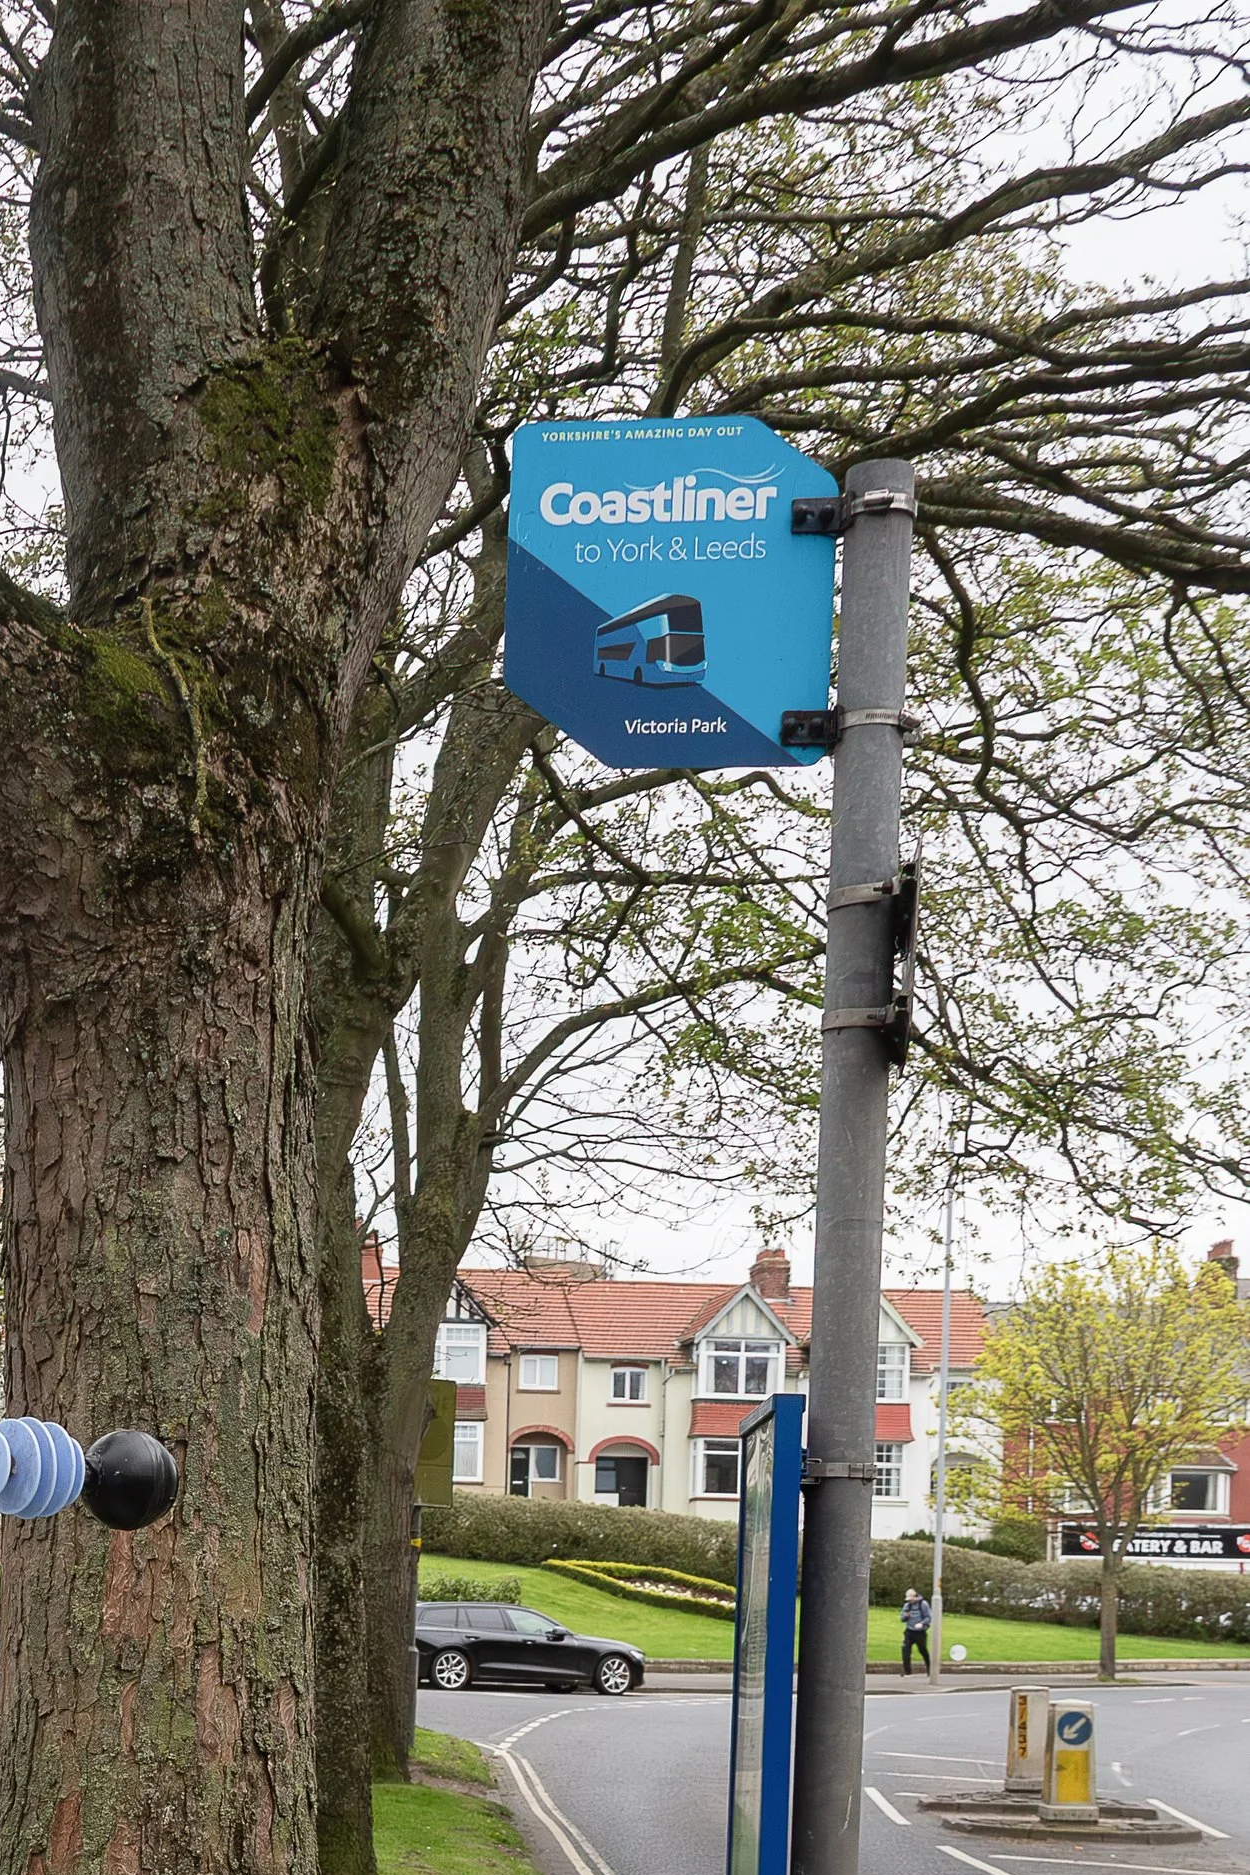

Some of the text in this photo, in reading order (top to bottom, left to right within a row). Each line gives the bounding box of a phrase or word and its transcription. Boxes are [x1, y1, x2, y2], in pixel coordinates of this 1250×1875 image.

[542, 426, 744, 442] YORKSHIRE'S AMAZING DAY OUT
[539, 475, 778, 526] Coastliner
[575, 531, 767, 563] to York & Leeds
[625, 717, 727, 735] Victoria Park
[1173, 1540, 1188, 1553] &
[1189, 1540, 1224, 1554] BAR
